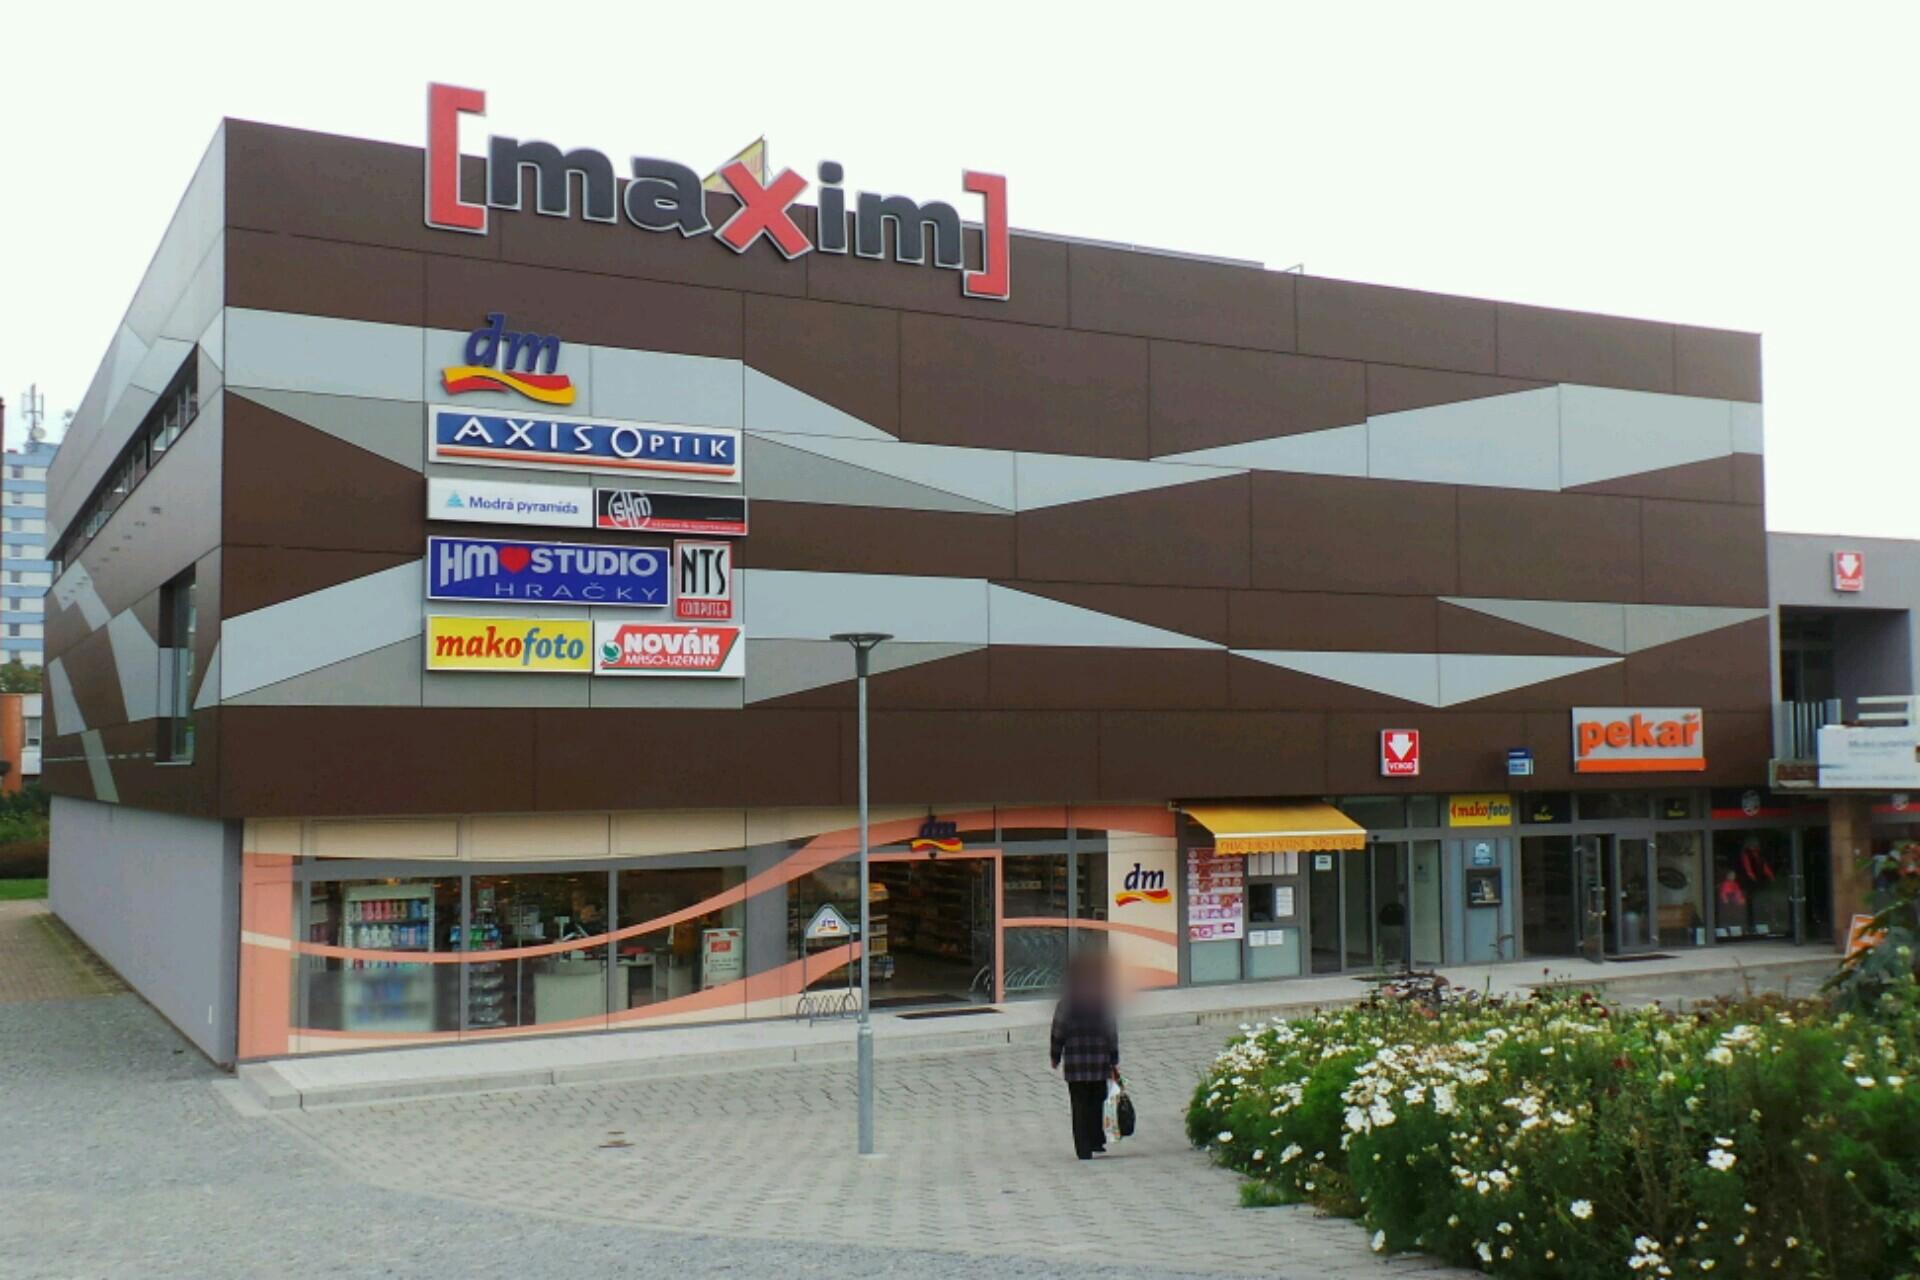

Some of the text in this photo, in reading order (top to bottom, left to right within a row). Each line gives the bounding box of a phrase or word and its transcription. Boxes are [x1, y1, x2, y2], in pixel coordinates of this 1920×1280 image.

[464, 312, 561, 374] dm
[468, 494, 579, 515] Modrá pyramida
[439, 541, 659, 587] HM STUDIO
[680, 546, 726, 595] NTS
[494, 582, 660, 601] HRAČKY
[680, 601, 729, 617] COMPUTER
[435, 625, 585, 666] makofoto
[623, 628, 721, 655] NOVÁK
[1578, 712, 1700, 757] pekař
[1124, 863, 1165, 890] dm
